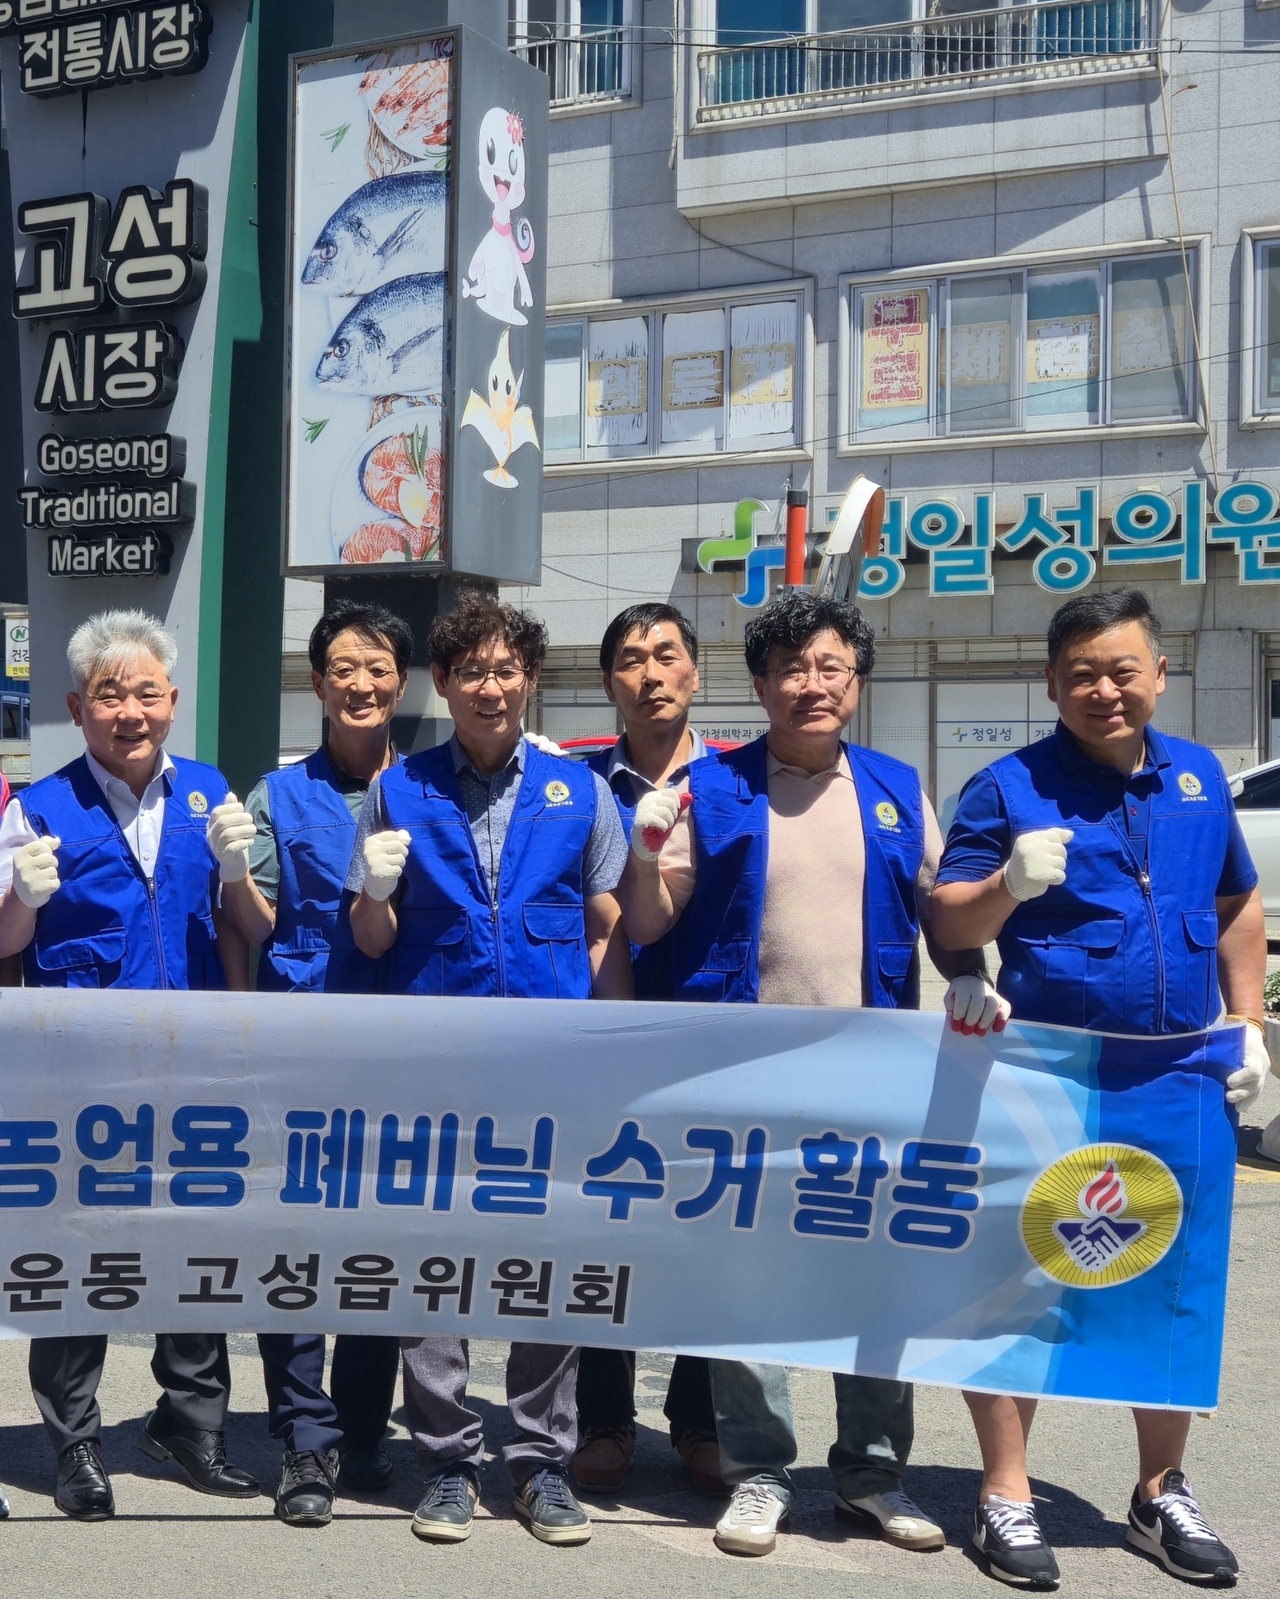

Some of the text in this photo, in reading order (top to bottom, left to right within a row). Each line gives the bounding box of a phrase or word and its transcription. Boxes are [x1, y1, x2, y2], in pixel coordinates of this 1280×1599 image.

[23, 3, 195, 89] 전통시장
[18, 187, 188, 311] 고성
[40, 329, 164, 405] 시장
[40, 438, 168, 473] Goseong
[20, 481, 178, 524] Traditional
[51, 535, 155, 572] Market
[700, 728, 770, 740] 가정의학과 의
[972, 727, 1012, 742] 정일성
[279, 1107, 555, 1215] 폐비닐
[581, 1120, 767, 1229] 수거
[793, 1131, 982, 1249] 활동
[178, 1253, 631, 1325] 고성읍위원회
